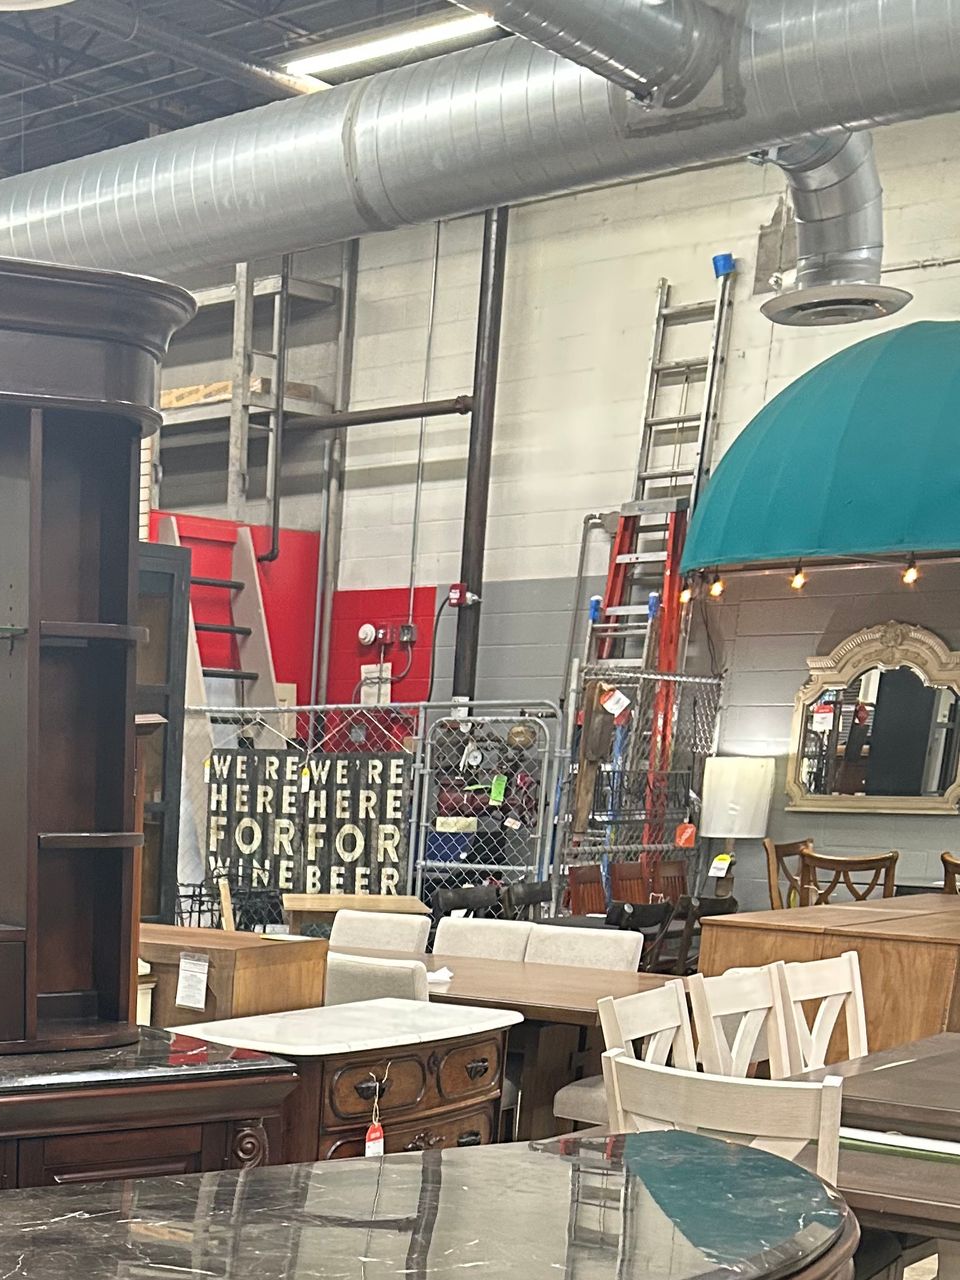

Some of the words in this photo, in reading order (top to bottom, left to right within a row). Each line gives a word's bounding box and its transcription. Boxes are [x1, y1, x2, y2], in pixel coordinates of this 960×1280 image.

[212, 755, 299, 780] WE'RE
[310, 759, 404, 784] WE'RE
[210, 784, 298, 814] HERE
[308, 790, 402, 818] HERE
[209, 816, 295, 856] FOR
[307, 824, 400, 863] FOR
[209, 856, 294, 889] WINE
[306, 865, 399, 896] BEER
